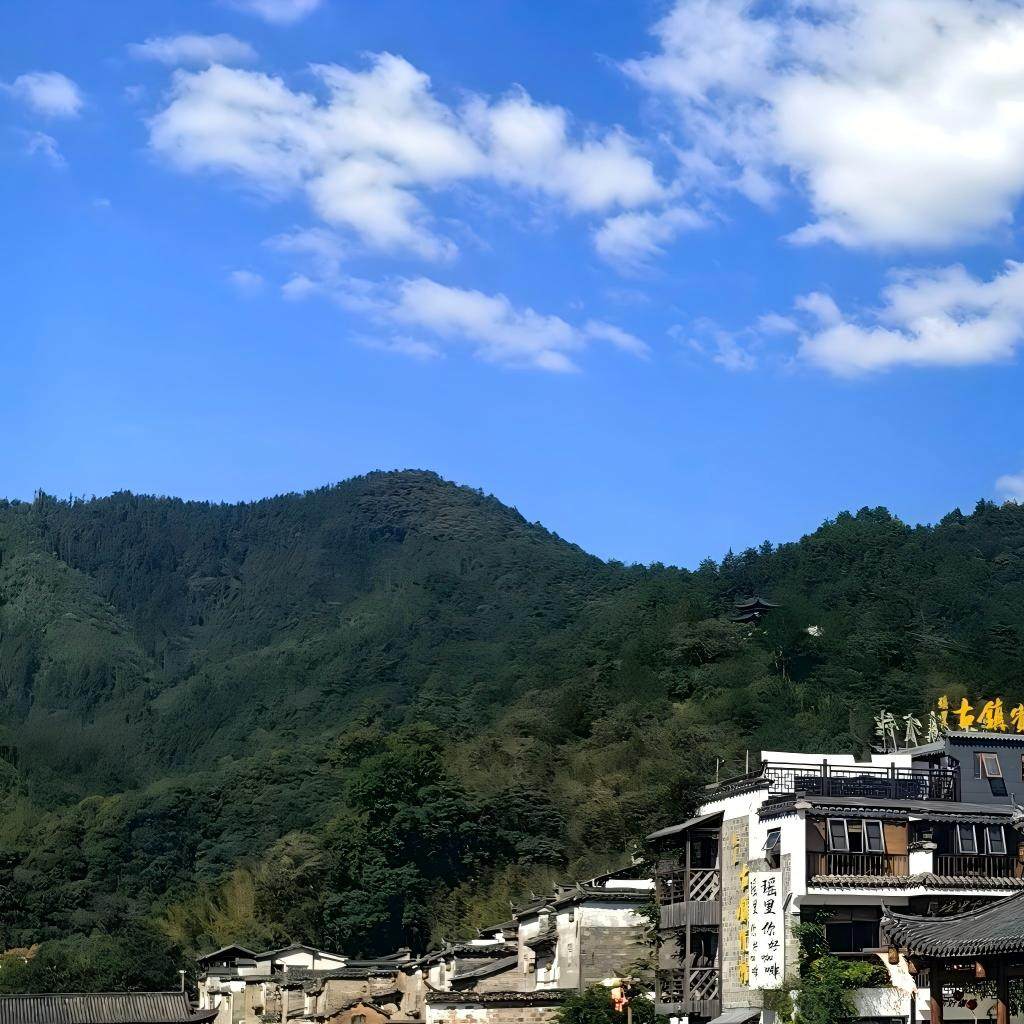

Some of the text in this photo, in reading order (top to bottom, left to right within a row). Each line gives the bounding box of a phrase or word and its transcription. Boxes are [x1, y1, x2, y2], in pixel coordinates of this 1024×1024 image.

[761, 877, 780, 979] 瑶里你好咖啡
